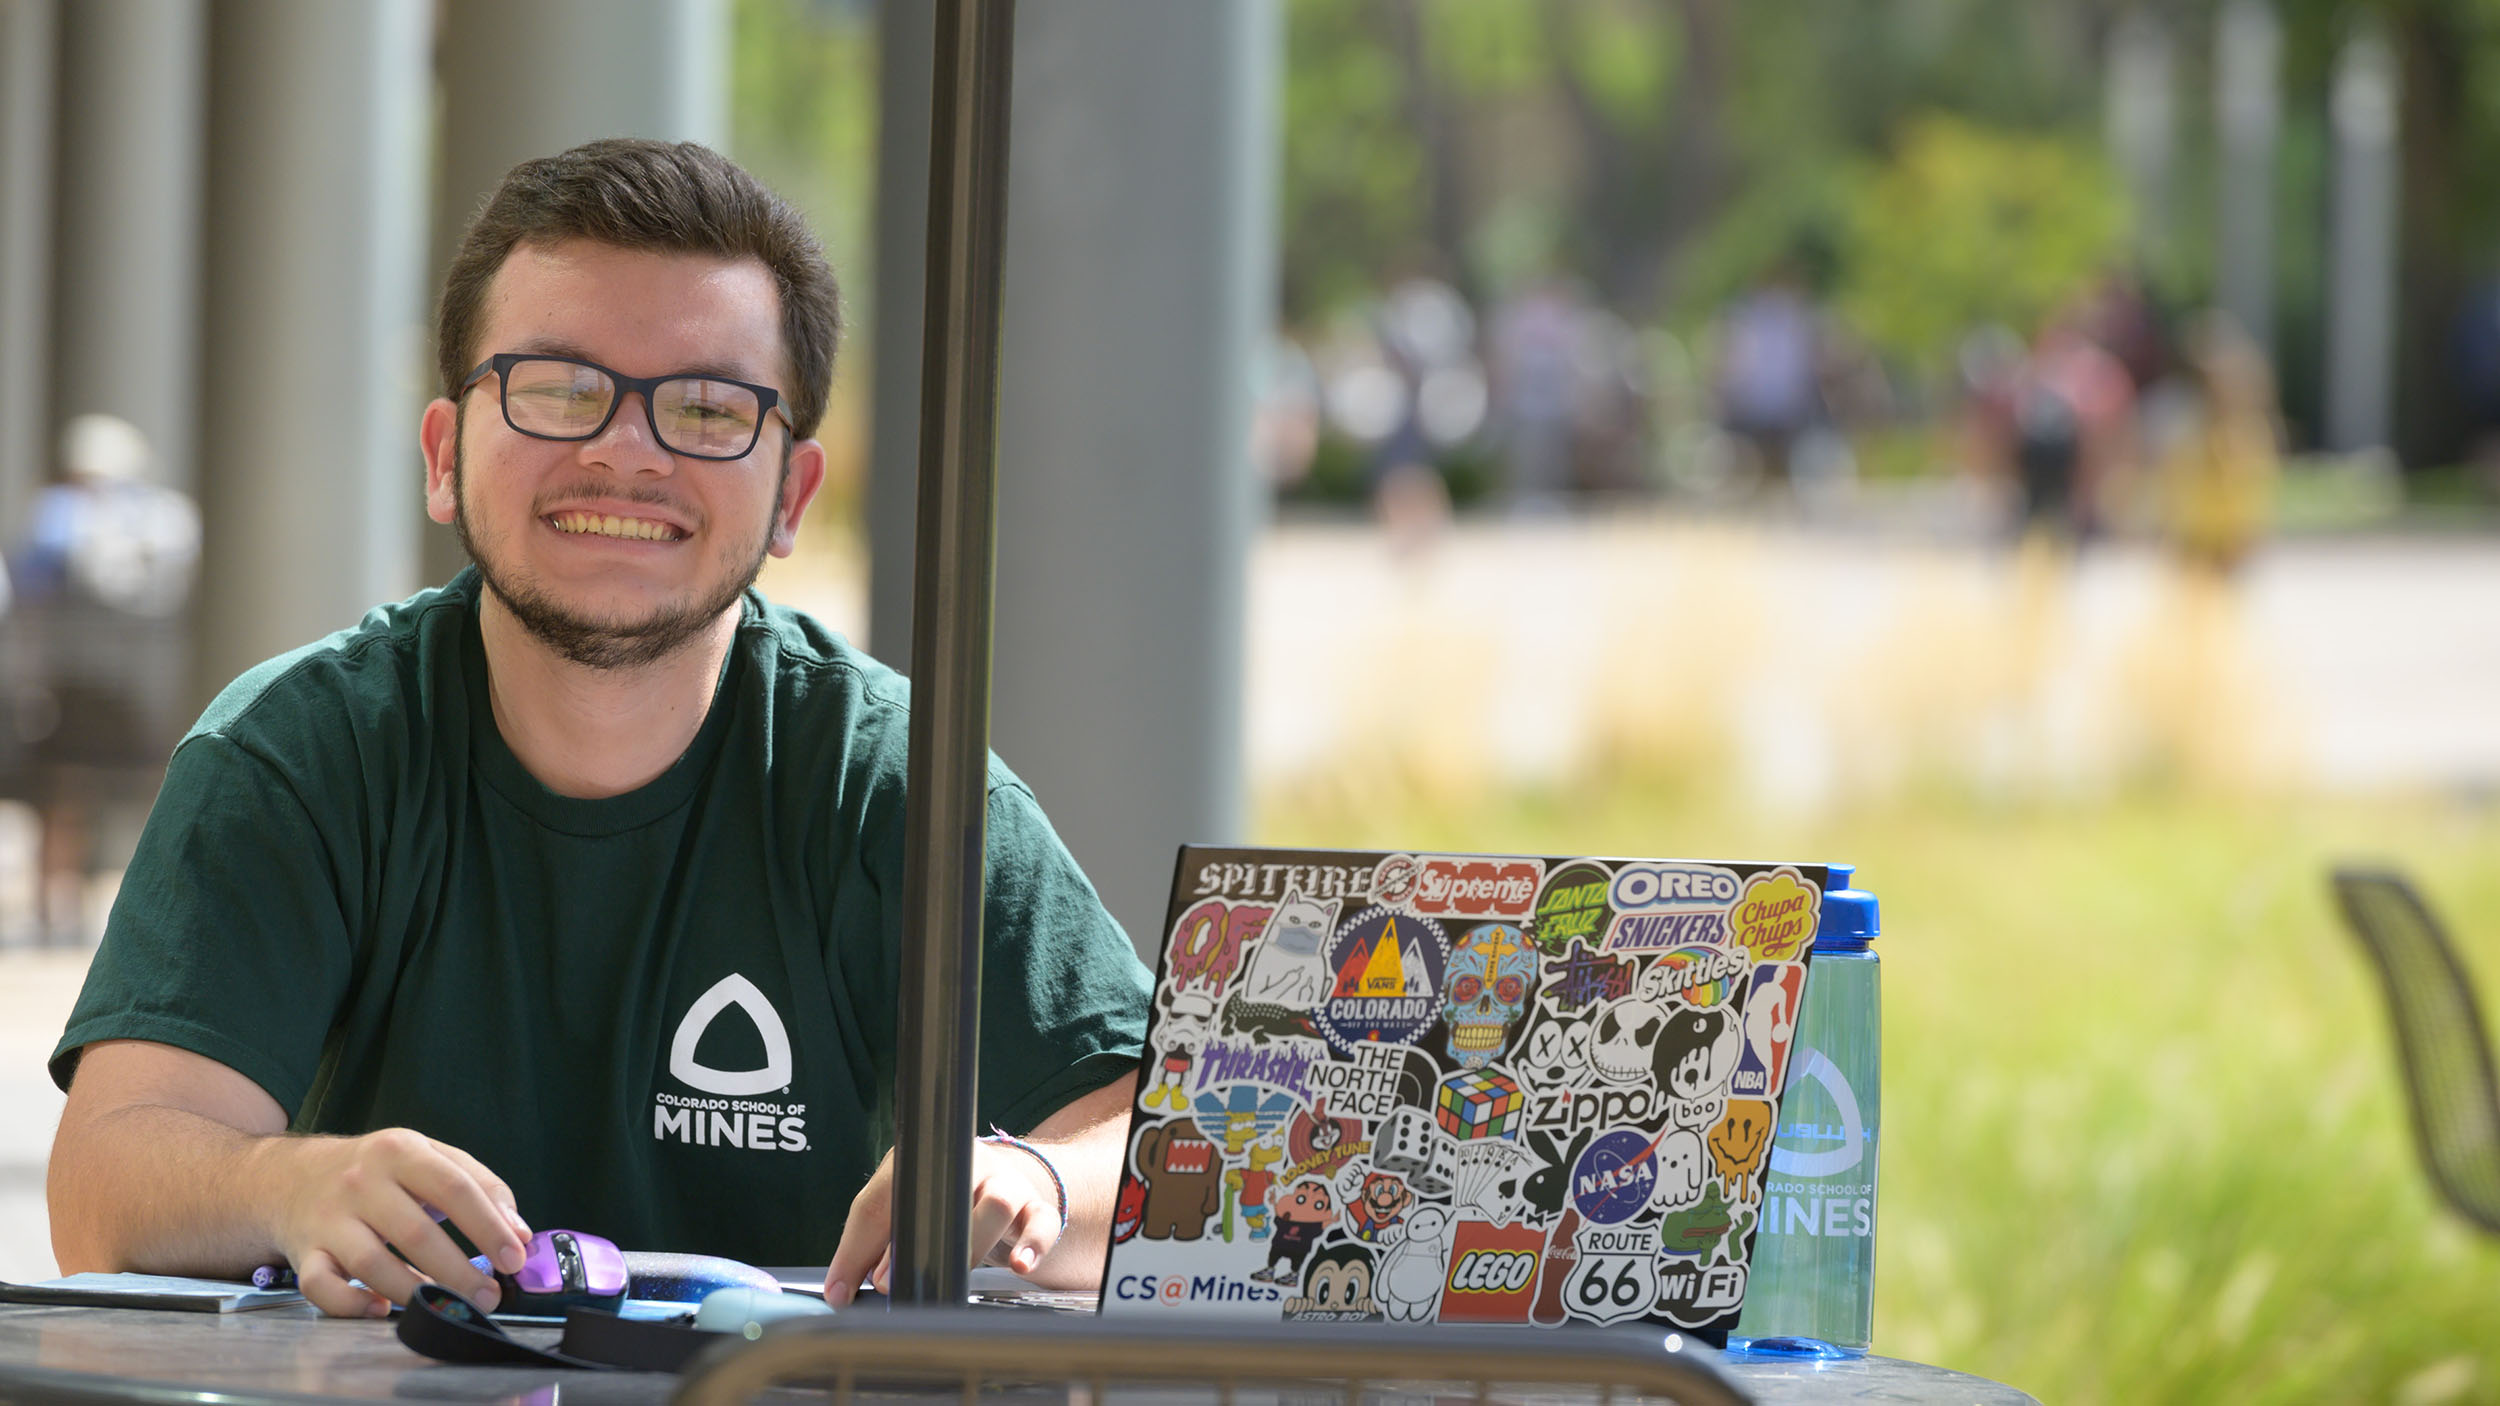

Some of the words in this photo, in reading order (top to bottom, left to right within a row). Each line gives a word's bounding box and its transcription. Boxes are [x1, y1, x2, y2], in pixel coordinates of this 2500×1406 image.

[1193, 863, 1373, 898] SPITFIRE
[1418, 869, 1534, 906] Supreme
[1617, 871, 1735, 905] OREO
[1537, 882, 1610, 914] SANTA
[1742, 895, 1805, 925] Chupa
[1611, 914, 1725, 949] SNICKERS
[1740, 917, 1803, 957] Chups
[1642, 950, 1745, 1001] Skittles
[1330, 998, 1427, 1020] COLORADO
[1357, 1046, 1403, 1070] THE
[1309, 1064, 1397, 1093] NORTH
[1735, 1071, 1764, 1089] NBA
[656, 1093, 729, 1111] COLORADO
[731, 1101, 784, 1115] SCHOOL
[787, 1104, 806, 1116] OF
[1329, 1091, 1392, 1116] FACE
[1681, 1101, 1715, 1118] boo
[654, 1104, 808, 1152] MINES
[1280, 1150, 1332, 1186] LOONEY
[1334, 1141, 1372, 1159] TUNE
[1579, 1160, 1654, 1196] NASA
[1765, 1181, 1805, 1195] RADO
[1809, 1184, 1858, 1196] SCHOOL
[1860, 1184, 1872, 1195] OF
[1588, 1232, 1652, 1252] ROUTE
[1454, 1252, 1535, 1290] LEGO
[1579, 1259, 1641, 1307] 66
[1292, 1311, 1337, 1321] ASTRO
[1339, 1312, 1369, 1321] BOY
